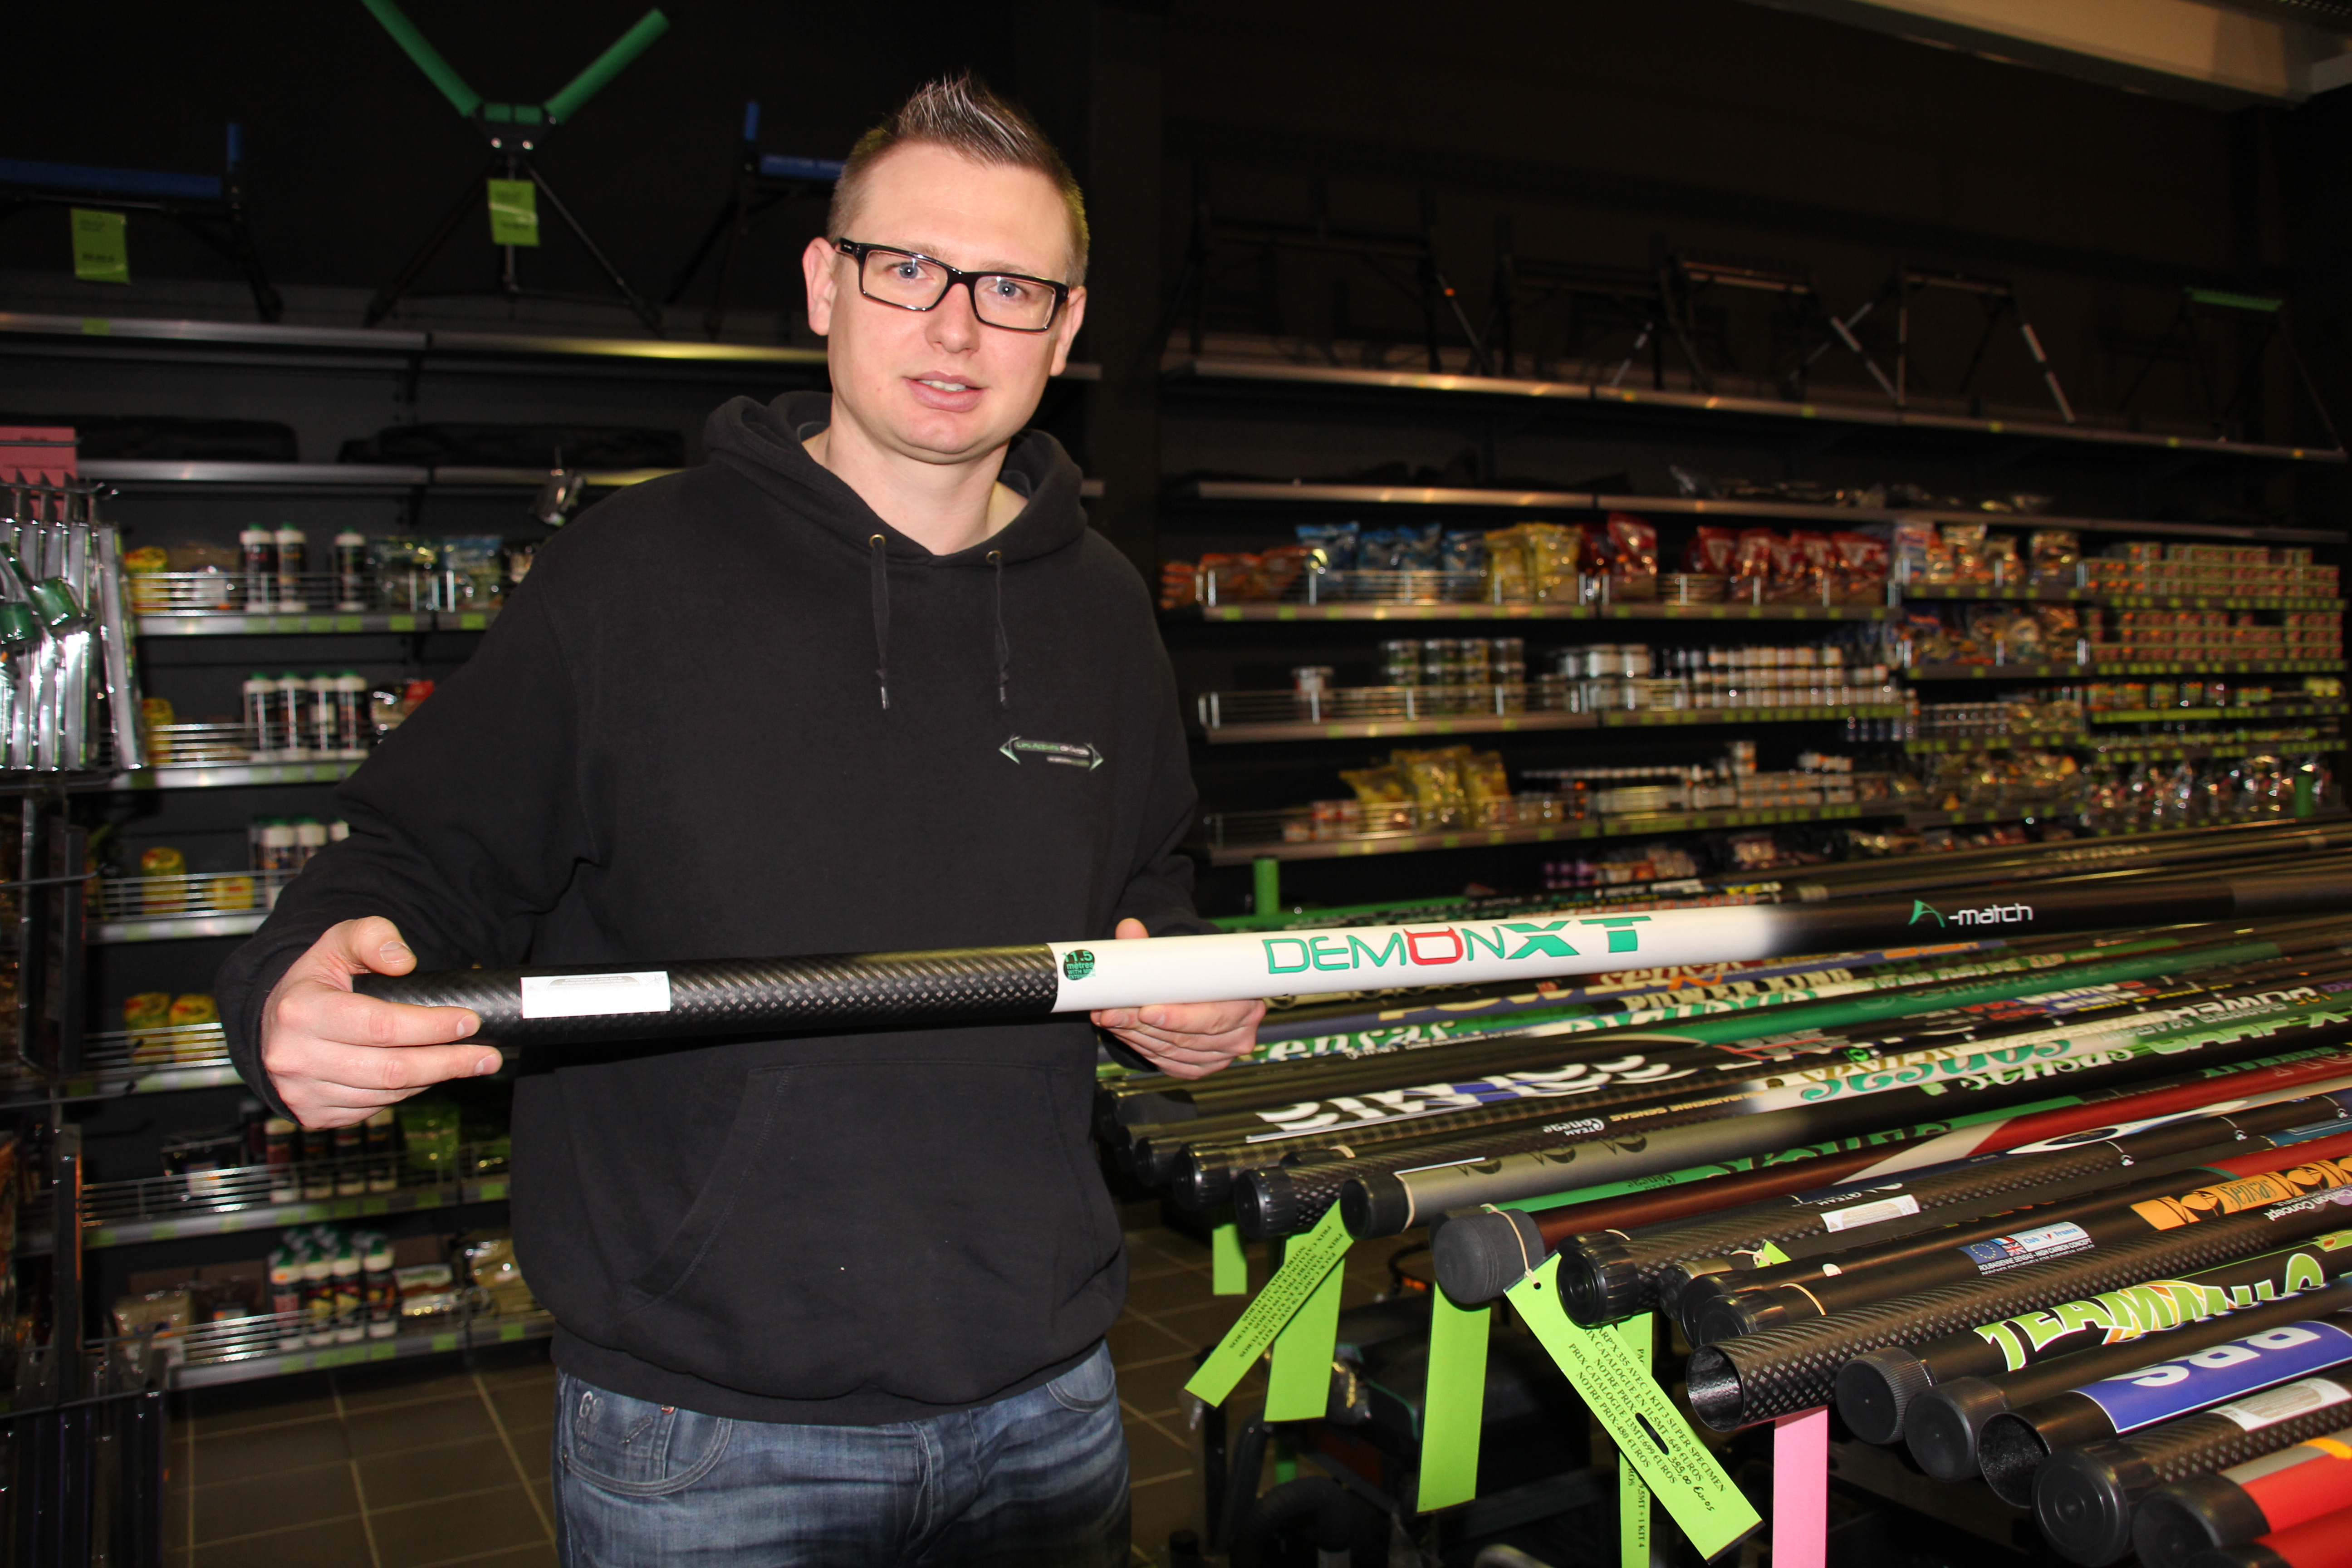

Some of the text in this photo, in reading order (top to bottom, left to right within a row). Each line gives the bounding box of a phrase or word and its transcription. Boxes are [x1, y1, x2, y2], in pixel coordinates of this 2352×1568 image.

[1062, 951, 1093, 962] 11.5
[2264, 1200, 2315, 1221] Concept
[1316, 1225, 1332, 1243] PRIX
[1327, 1232, 1343, 1250] PRIX
[2023, 1235, 2040, 1245] Club
[1281, 1241, 1318, 1285] CATALOGUE
[1285, 1245, 1306, 1269] NOTRE
[2014, 1252, 2034, 1263] SENSAS
[2034, 1249, 2049, 1257] HIGH
[2048, 1243, 2069, 1254] CARBON
[2068, 1238, 2092, 1249] CONCEPT
[1293, 1249, 1329, 1292] CATALOGUE
[1296, 1253, 1317, 1277] NOTRE
[1593, 1358, 1620, 1391] NOTRE
[1568, 1343, 1678, 1485] PRIX CATALOGUE 13MT:699 €UROS
[1575, 1371, 1651, 1469] NOTRE PRIX:480 €UROS
[1593, 1340, 1637, 1395] CATALOGUE
[1633, 1393, 1647, 1407] EN
[1643, 1406, 1670, 1437] 11,5MT
[1665, 1435, 1682, 1454] :649
[1677, 1451, 1704, 1482] €UROS
[1597, 1325, 1621, 1353] ARP'X
[1615, 1351, 1630, 1367] 335
[1626, 1365, 1648, 1391] AVEC
[1648, 1394, 1666, 1413] KIT
[1661, 1411, 1670, 1419] 3
[1666, 1416, 1692, 1448] SUPER
[1687, 1445, 1727, 1494] SPECIMEN
[1666, 1453, 1694, 1487] 399,00
[1637, 1524, 1645, 1541] KIT
